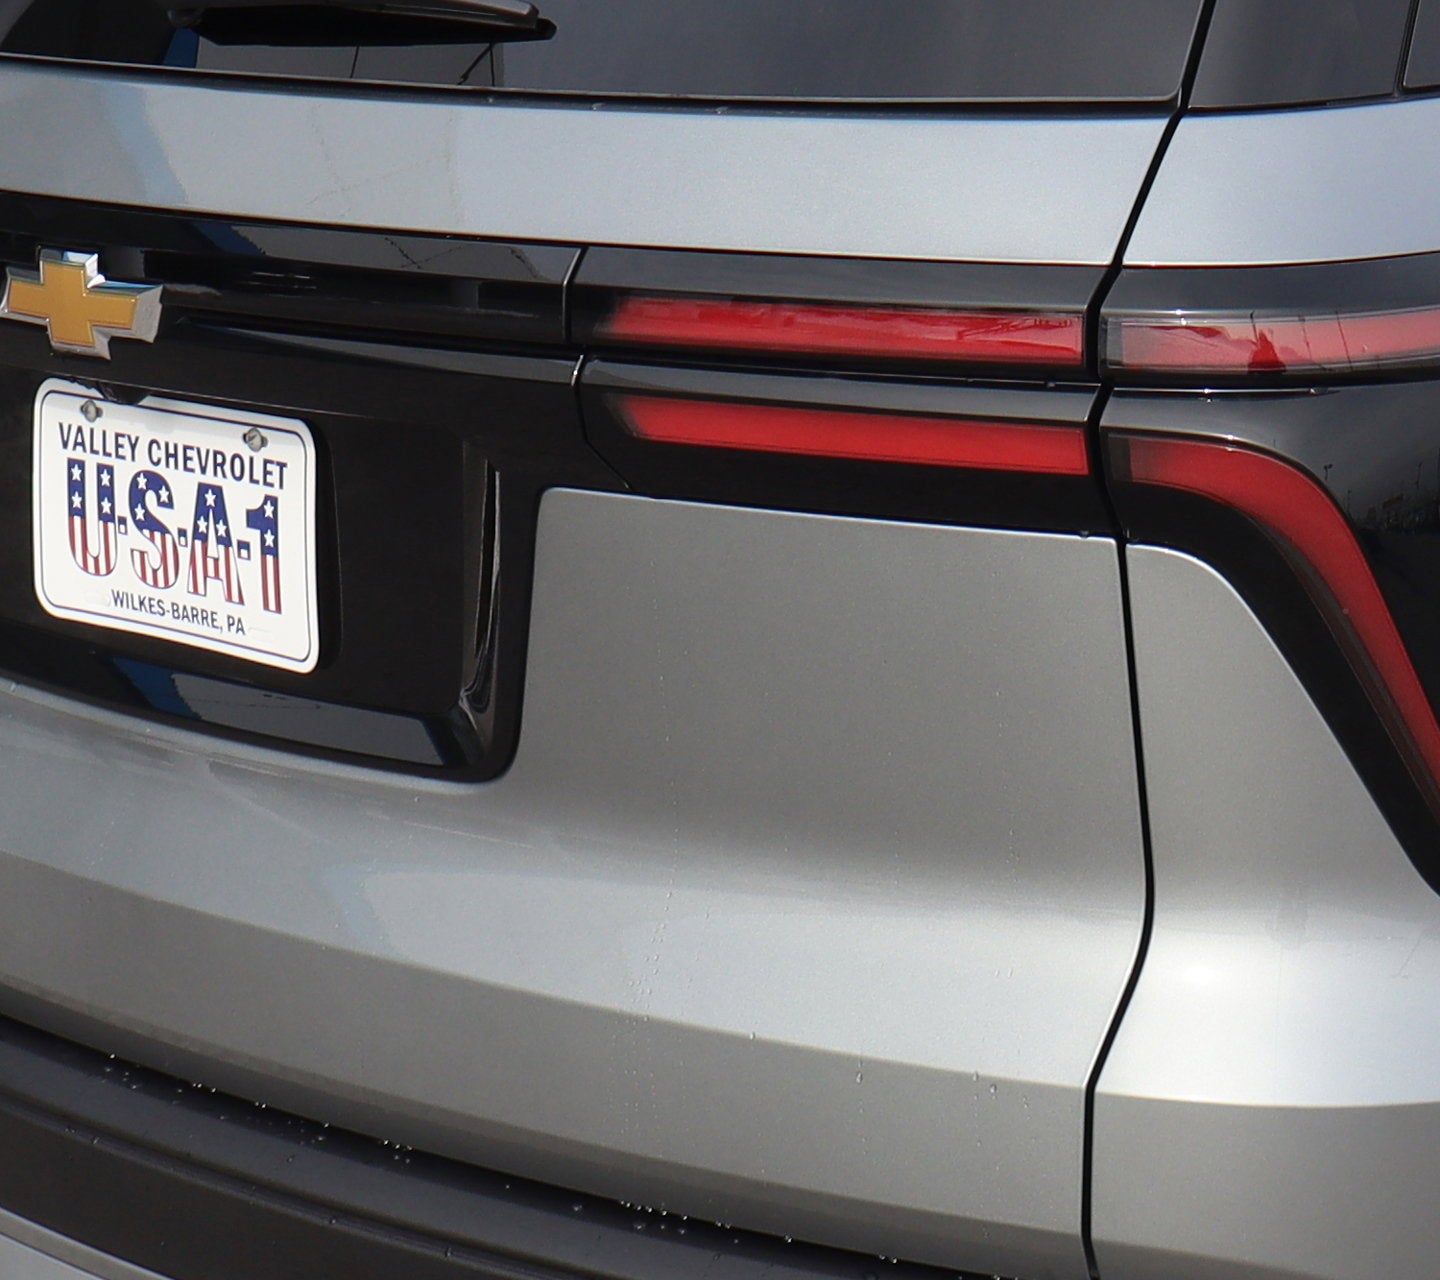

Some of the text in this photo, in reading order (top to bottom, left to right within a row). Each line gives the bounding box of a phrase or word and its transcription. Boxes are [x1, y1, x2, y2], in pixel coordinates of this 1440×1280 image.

[58, 422, 288, 490] VALLEY CHEVROLET
[111, 589, 246, 635] WILKES-BARRE, PA
